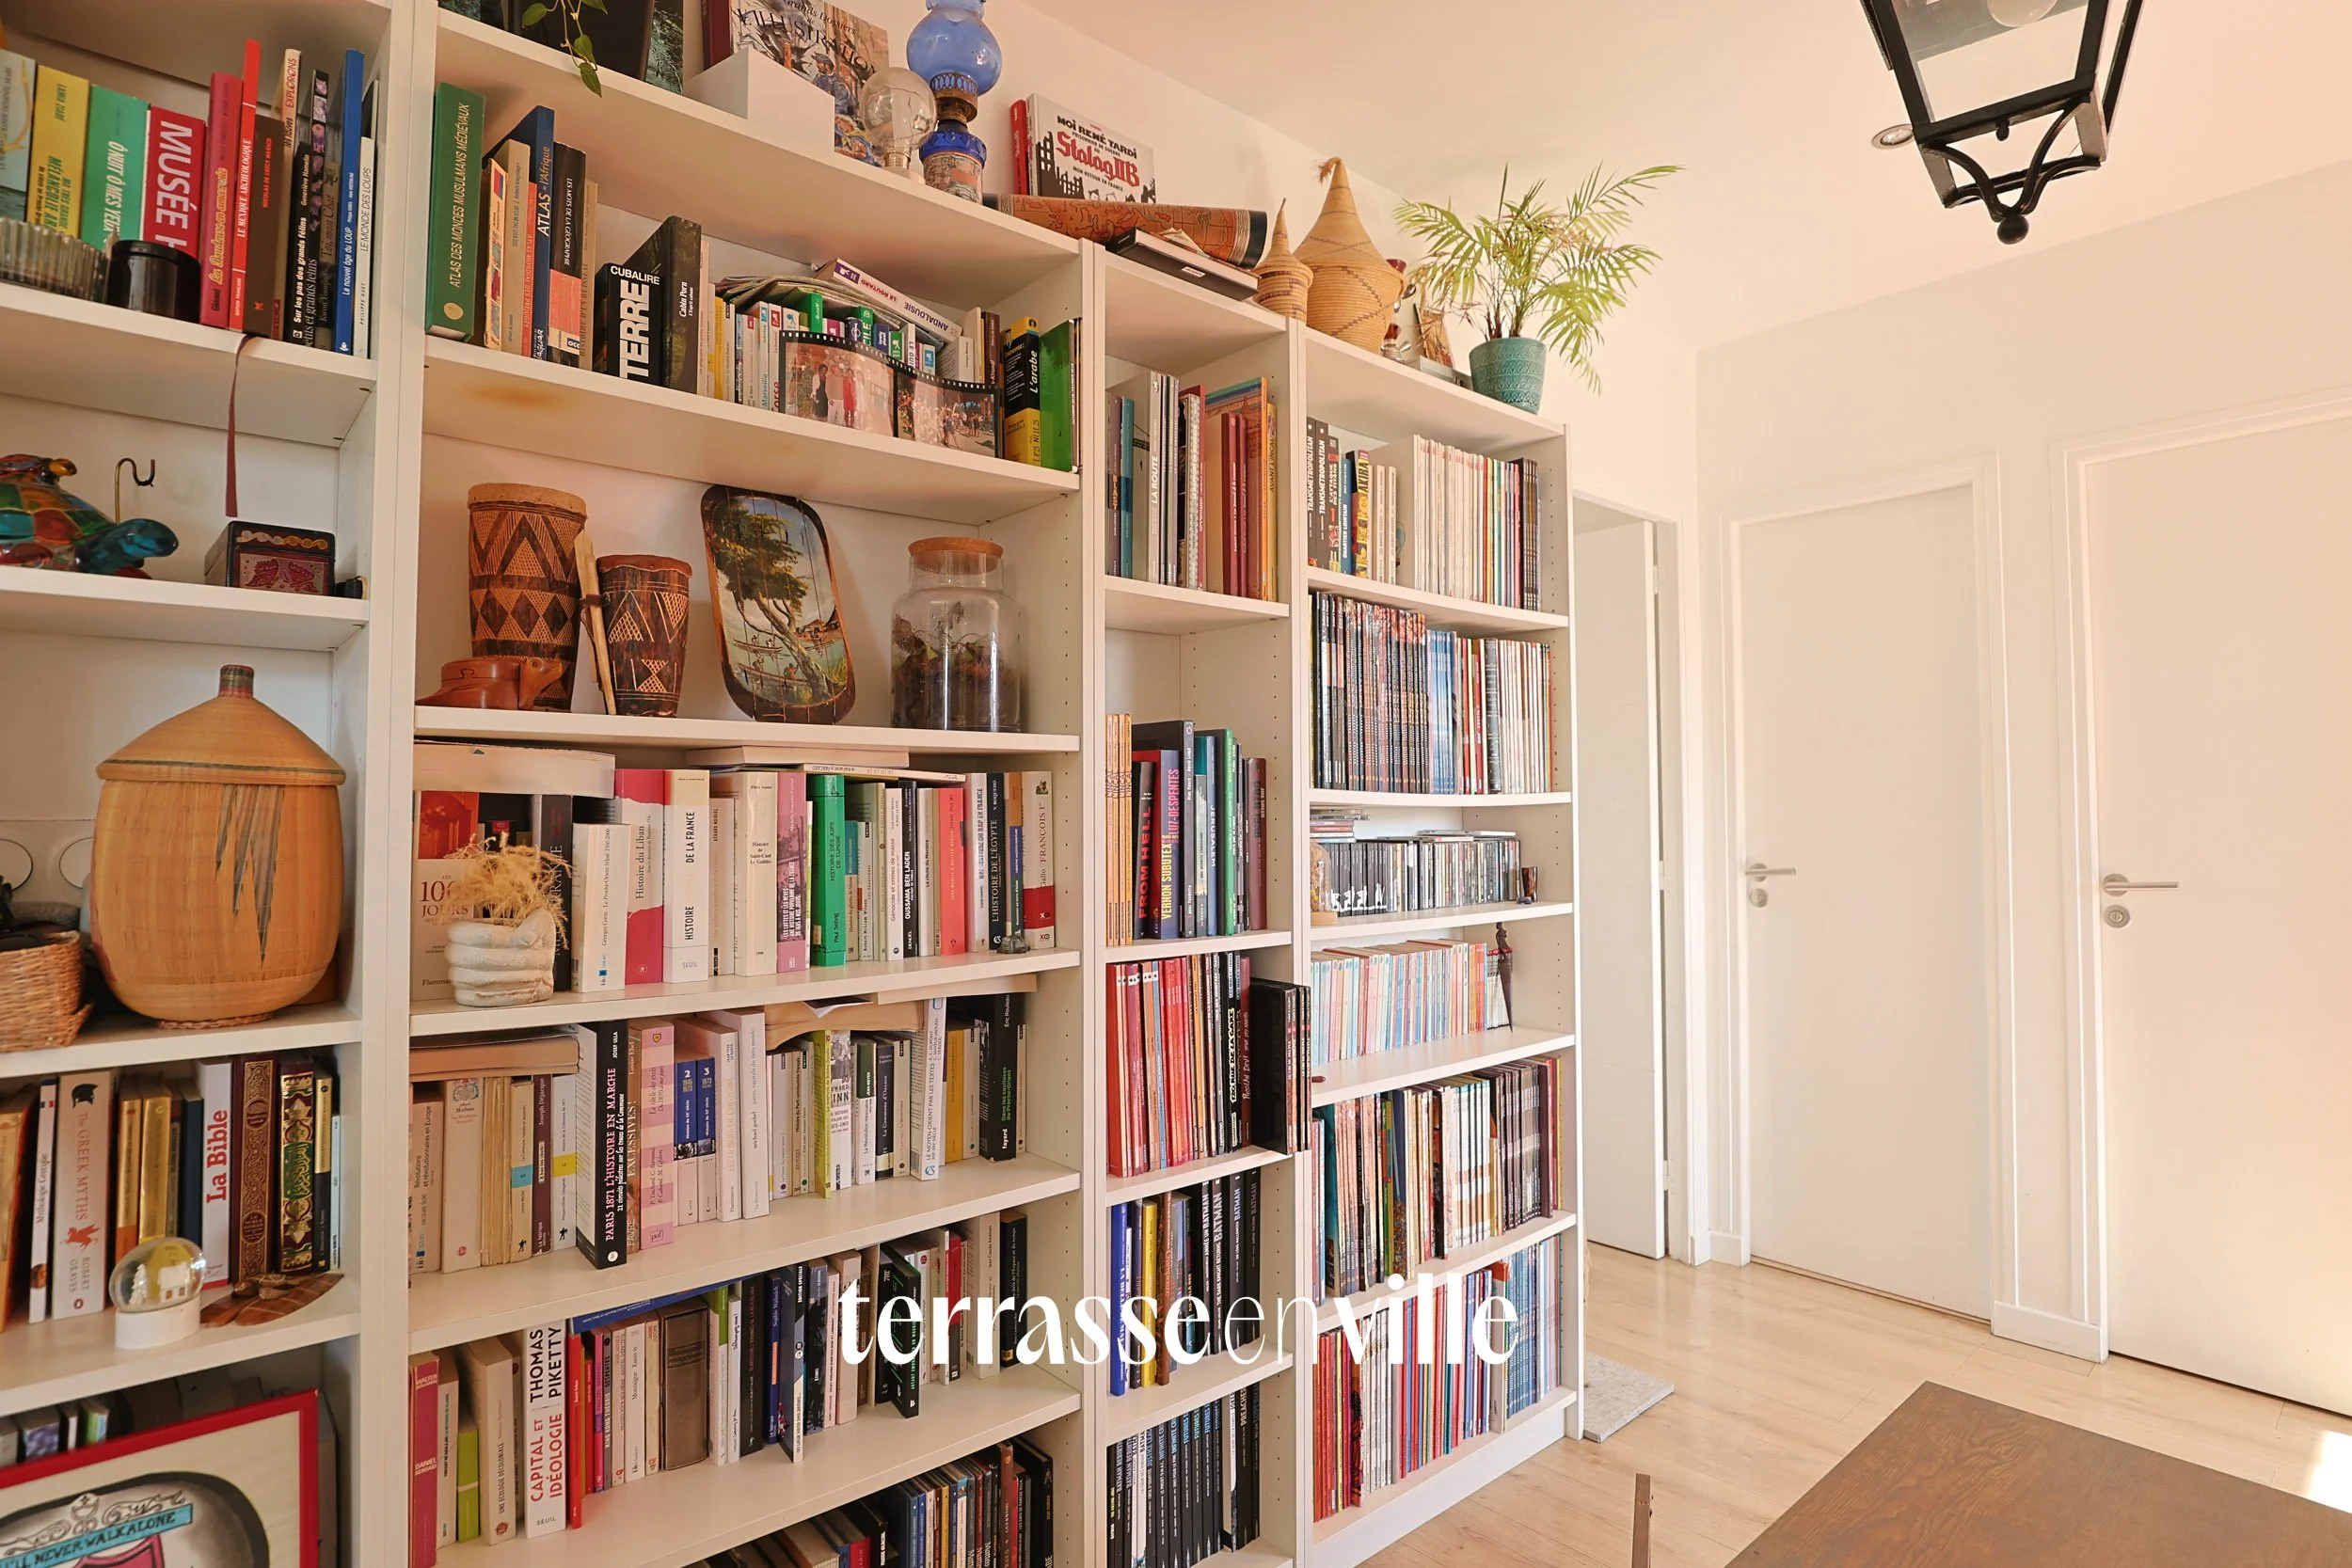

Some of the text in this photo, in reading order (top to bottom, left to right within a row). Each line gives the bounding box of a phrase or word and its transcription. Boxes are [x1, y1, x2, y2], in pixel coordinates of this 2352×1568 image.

[820, 11, 856, 34] Dossiers
[285, 57, 296, 107] EXPLORONS
[1078, 124, 1106, 145] RENÉ
[106, 150, 124, 176] NUIT
[155, 120, 197, 230] MUSÉE
[539, 147, 549, 185] l'Afrique
[105, 183, 123, 207] MES
[237, 195, 247, 227] MEXIQUE
[360, 167, 372, 252] LE MONDE DES LOUPS
[450, 103, 469, 287] ATLAS DES MONDES MUSULMANS MÉDIÉVAUX
[297, 216, 307, 238] félins
[537, 194, 550, 237] ATLAS
[564, 216, 571, 225] LA
[565, 207, 572, 216] DE
[236, 227, 246, 237] LE
[344, 227, 353, 245] LOUP
[296, 240, 307, 265] grands
[342, 254, 353, 266] âge
[208, 269, 224, 286] La
[295, 266, 304, 280] des
[295, 281, 306, 295] pas
[342, 266, 351, 288] nouvel
[611, 265, 660, 285] CUBALIRE
[678, 281, 688, 317] Cabin Porn
[619, 279, 650, 380] TERRE
[903, 301, 948, 331] ANDALOUSIE
[1029, 350, 1039, 394] L'arabe
[1358, 462, 1369, 493] AKIRA
[1152, 491, 1158, 503] LA
[1168, 768, 1180, 834] LUZ-DESPENTES
[1039, 813, 1047, 863] FRANÇOIS
[635, 825, 644, 899] Histoire du Liban
[685, 812, 694, 941] HISTOIRE DE LA FRANCE
[991, 861, 998, 872] DE
[1138, 806, 1151, 918] FROM HELL
[1161, 843, 1172, 919] VERNON SUBUTEX
[991, 875, 999, 922] L'HISTOIRE
[684, 1069, 691, 1078] 2
[704, 1067, 710, 1075] 3
[75, 1129, 91, 1172] GREEK
[206, 1110, 228, 1203] La Bible
[604, 1068, 616, 1242] PARIS 1871 L'HISTOIRE EN MARCHE
[75, 1175, 90, 1220] MYTHS
[423, 1179, 430, 1187] et
[1213, 1192, 1223, 1242] BATMAN
[69, 1259, 79, 1292] GRAVES
[81, 1257, 91, 1291] ROBERT
[530, 1326, 562, 1403] THOMAS PIKETTY
[415, 1457, 437, 1470] DANIEL
[530, 1413, 563, 1502] CAPITAL ET IDÉOLOGIE
[536, 1516, 556, 1526] SEUIL
